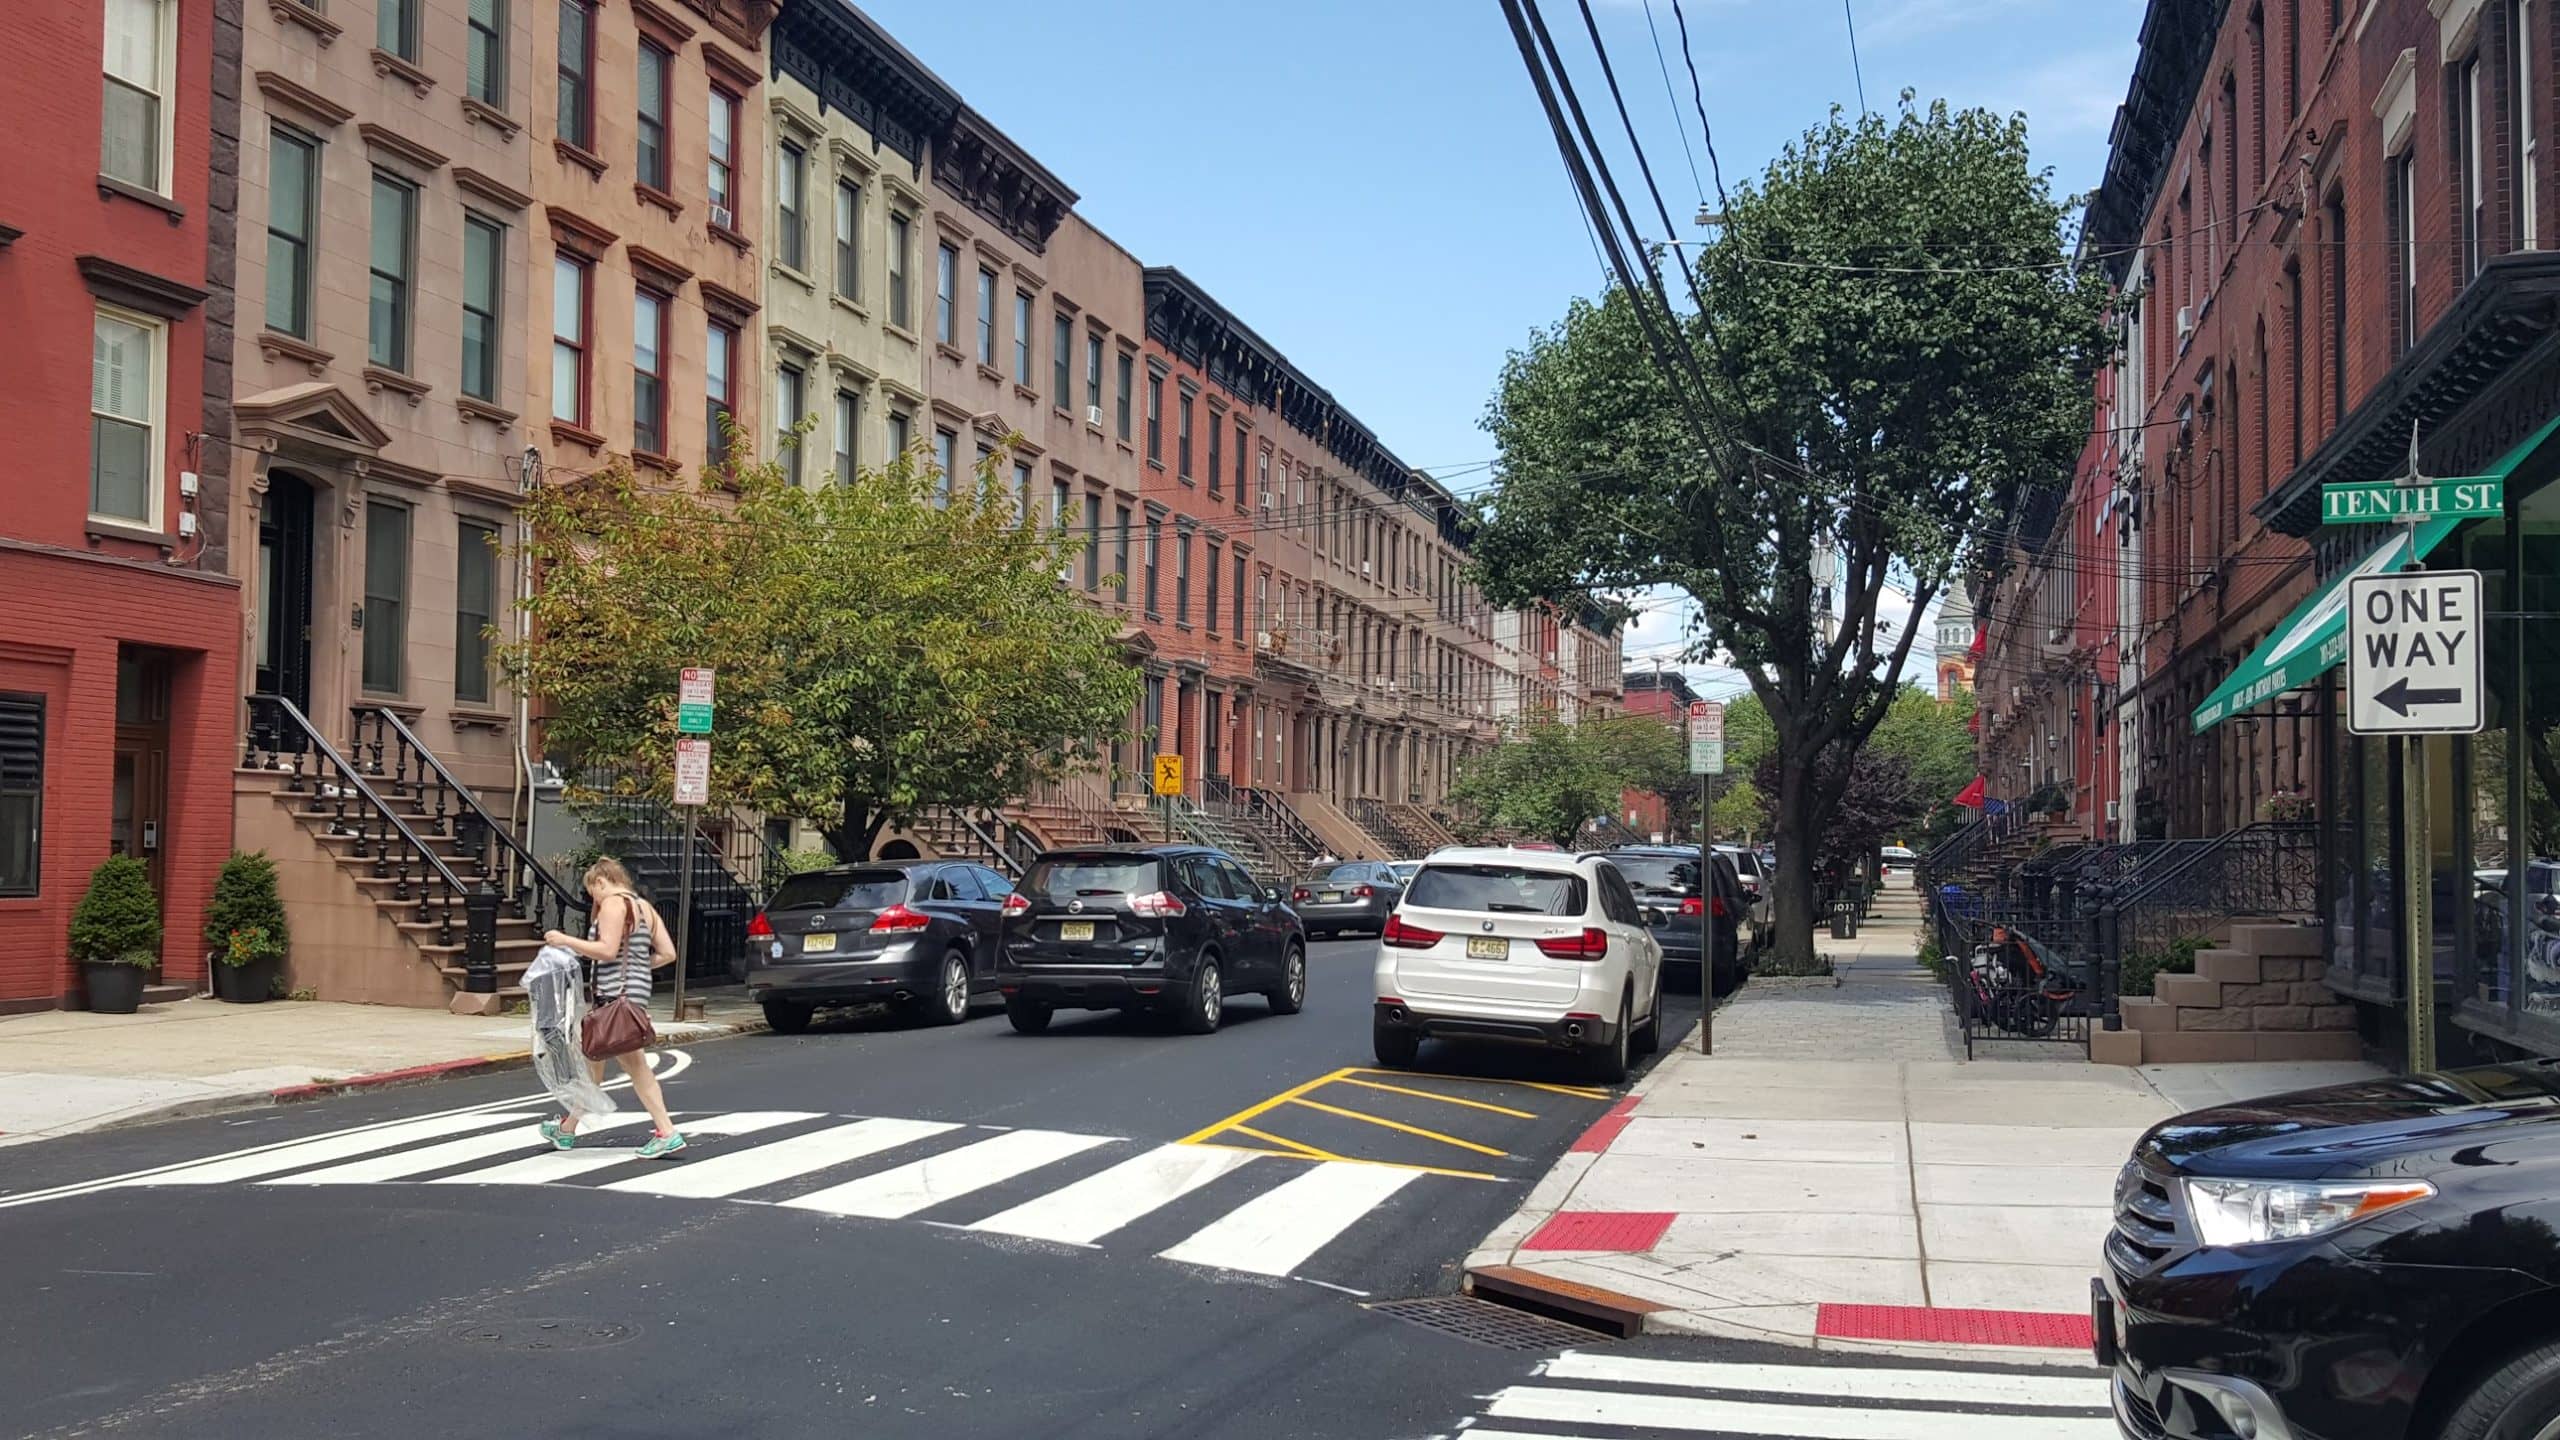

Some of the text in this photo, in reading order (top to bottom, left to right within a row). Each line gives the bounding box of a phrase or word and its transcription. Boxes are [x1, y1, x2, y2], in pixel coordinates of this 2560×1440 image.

[2324, 483, 2504, 517] TENTH ST.
[2366, 587, 2463, 625] ONE
[2366, 630, 2467, 669] WAY
[684, 670, 697, 680] NO
[1693, 704, 1705, 714] NO
[680, 742, 693, 751] NO
